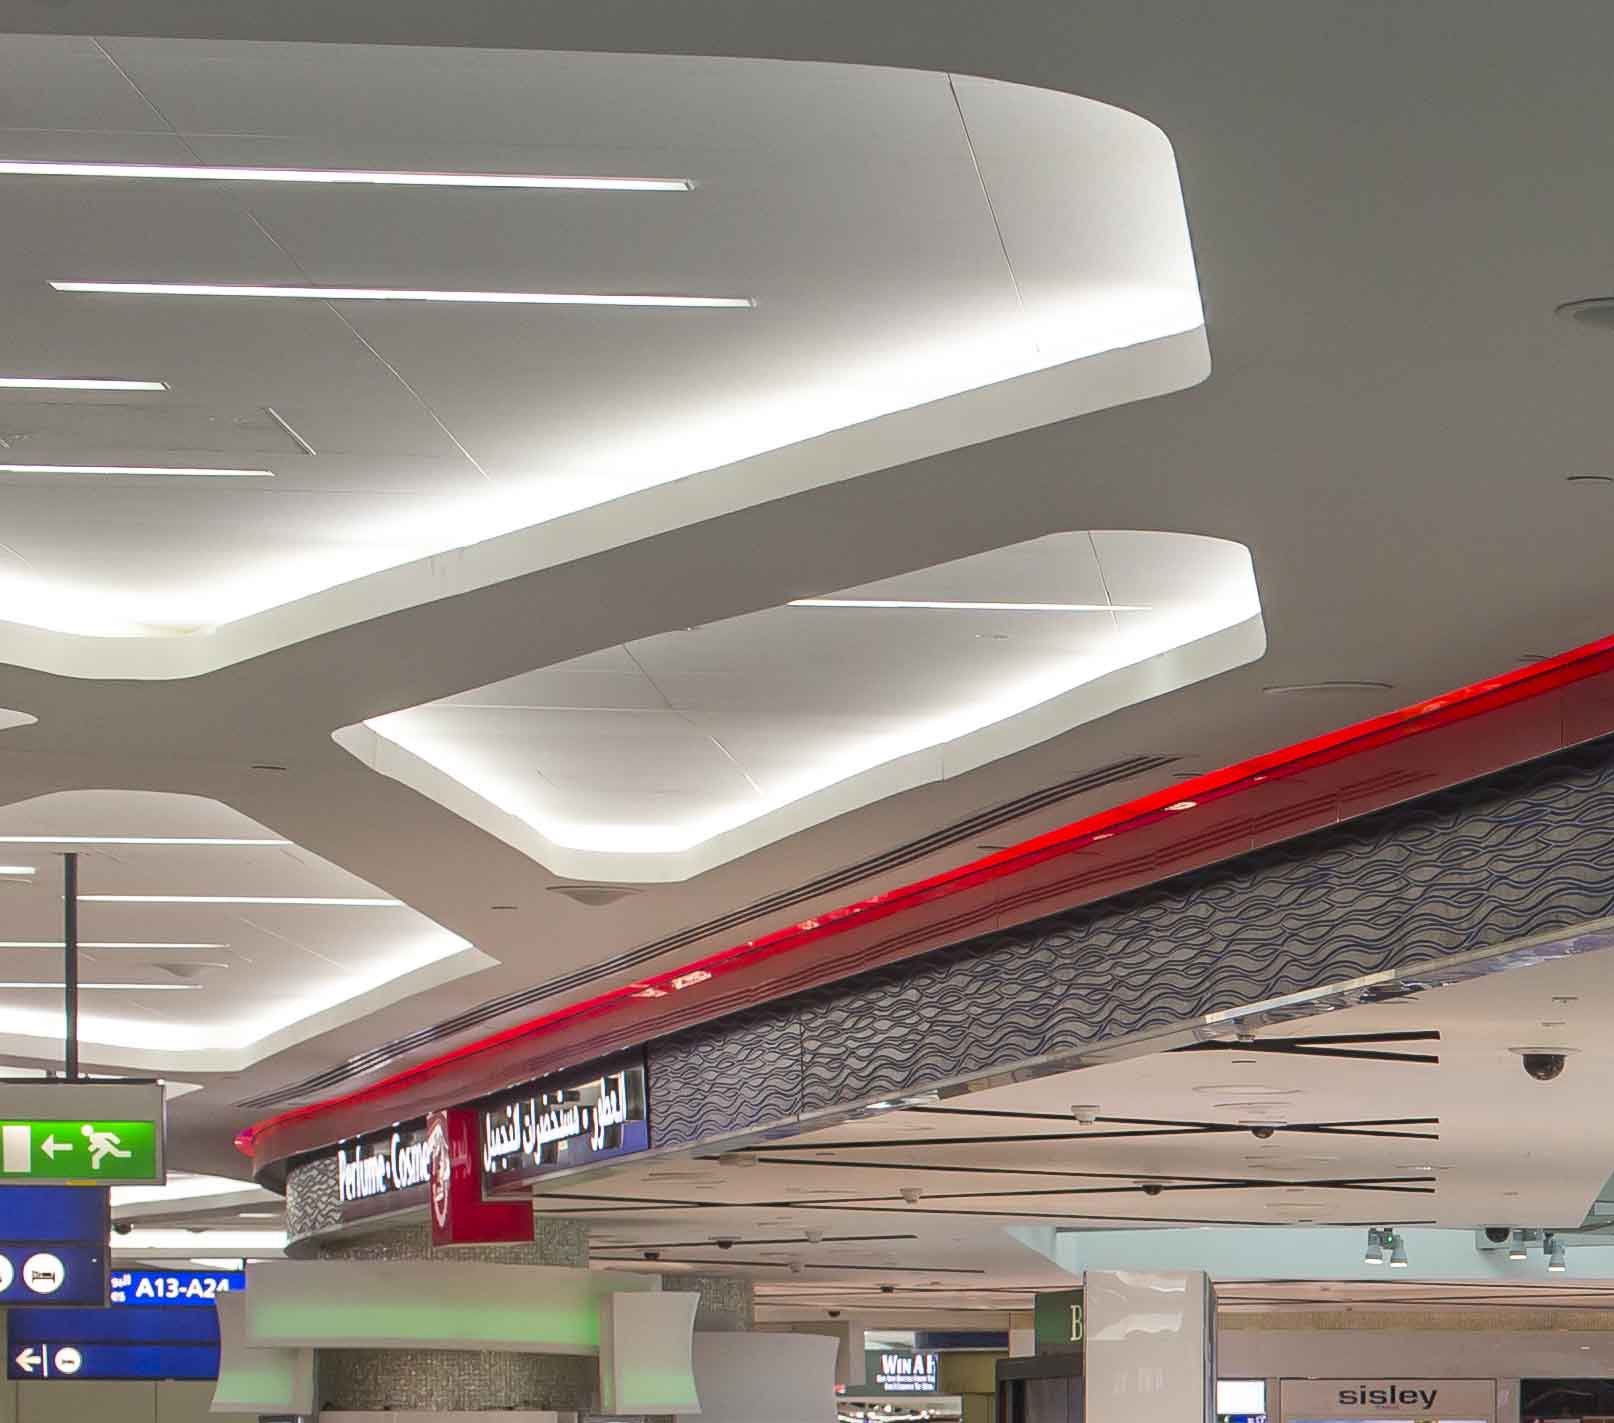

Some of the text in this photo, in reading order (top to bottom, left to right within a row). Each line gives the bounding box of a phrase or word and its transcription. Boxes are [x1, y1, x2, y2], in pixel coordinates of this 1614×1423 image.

[337, 1132, 431, 1202] Perfume Cosme
[135, 1278, 230, 1299] A13-A24
[1338, 1385, 1438, 1409] sisley
